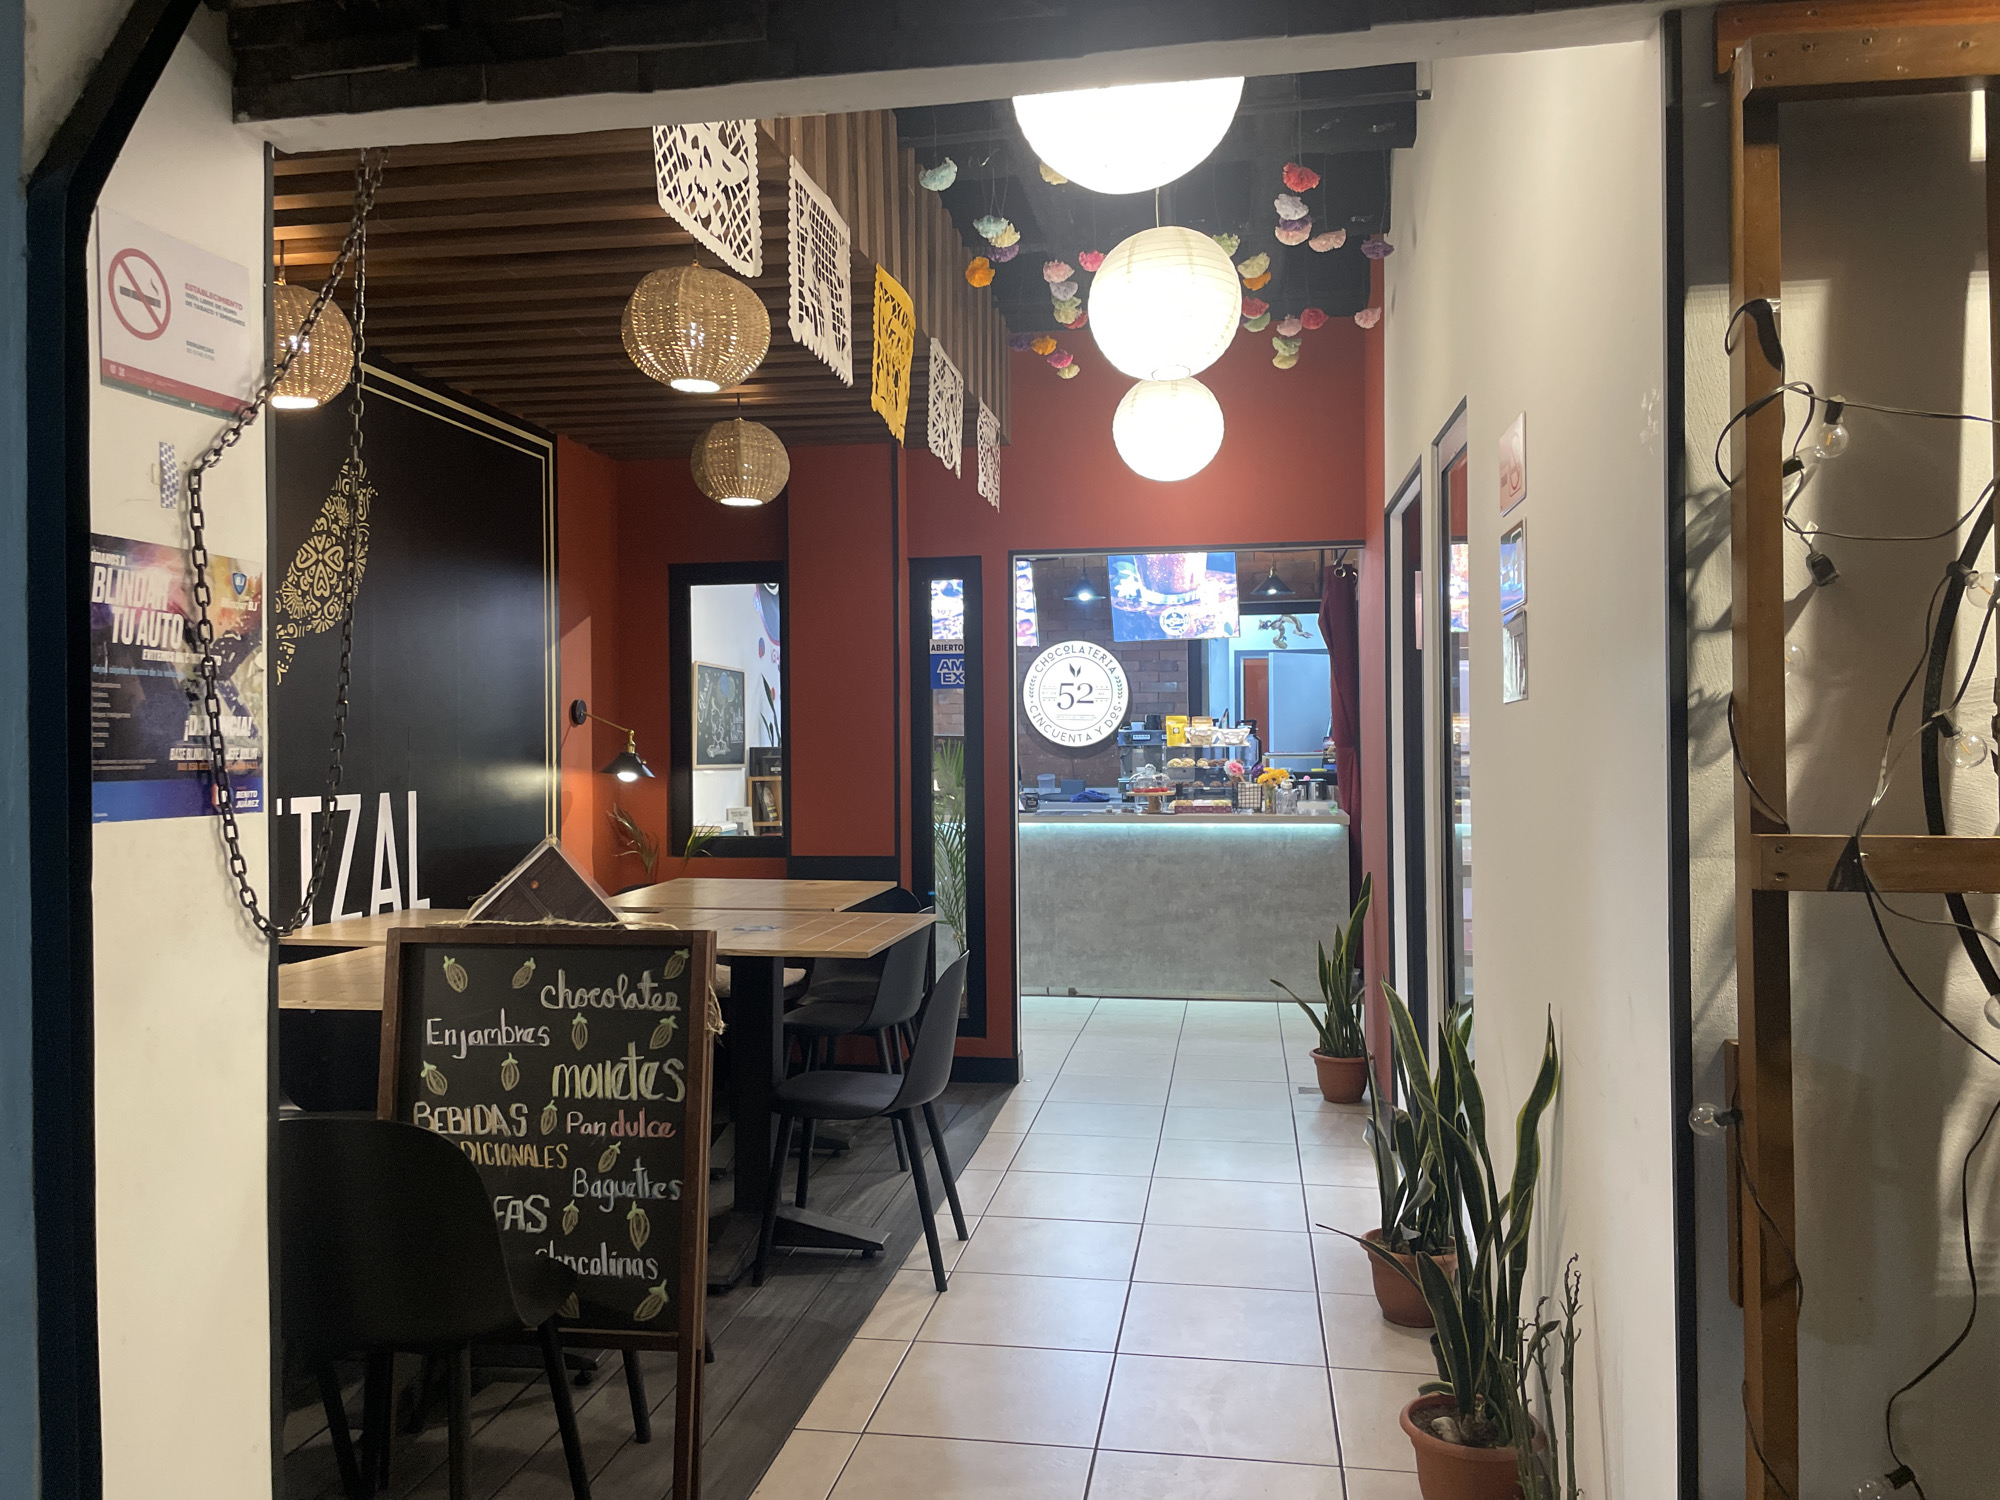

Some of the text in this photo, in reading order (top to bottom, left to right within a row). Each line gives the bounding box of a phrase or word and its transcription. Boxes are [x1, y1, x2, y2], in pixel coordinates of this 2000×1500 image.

[185, 282, 243, 311] ESTABLECIMIENTO
[185, 300, 193, 308] DE
[193, 303, 215, 316] TABACO
[91, 565, 170, 611] BLINDAR
[111, 605, 185, 650] TU AUTO
[930, 643, 964, 652] ABIERTO
[1034, 644, 1117, 675] CHOCOLATERIA
[936, 659, 965, 673] AM
[940, 671, 965, 685] EX
[1057, 682, 1095, 711] 52
[1029, 704, 1123, 743] CINCUENTA Y DOS
[235, 790, 258, 799] BENITO
[276, 790, 431, 928] TZAL
[413, 1101, 529, 1138] BEBIDAS
[565, 1107, 677, 1138] Pan dulce
